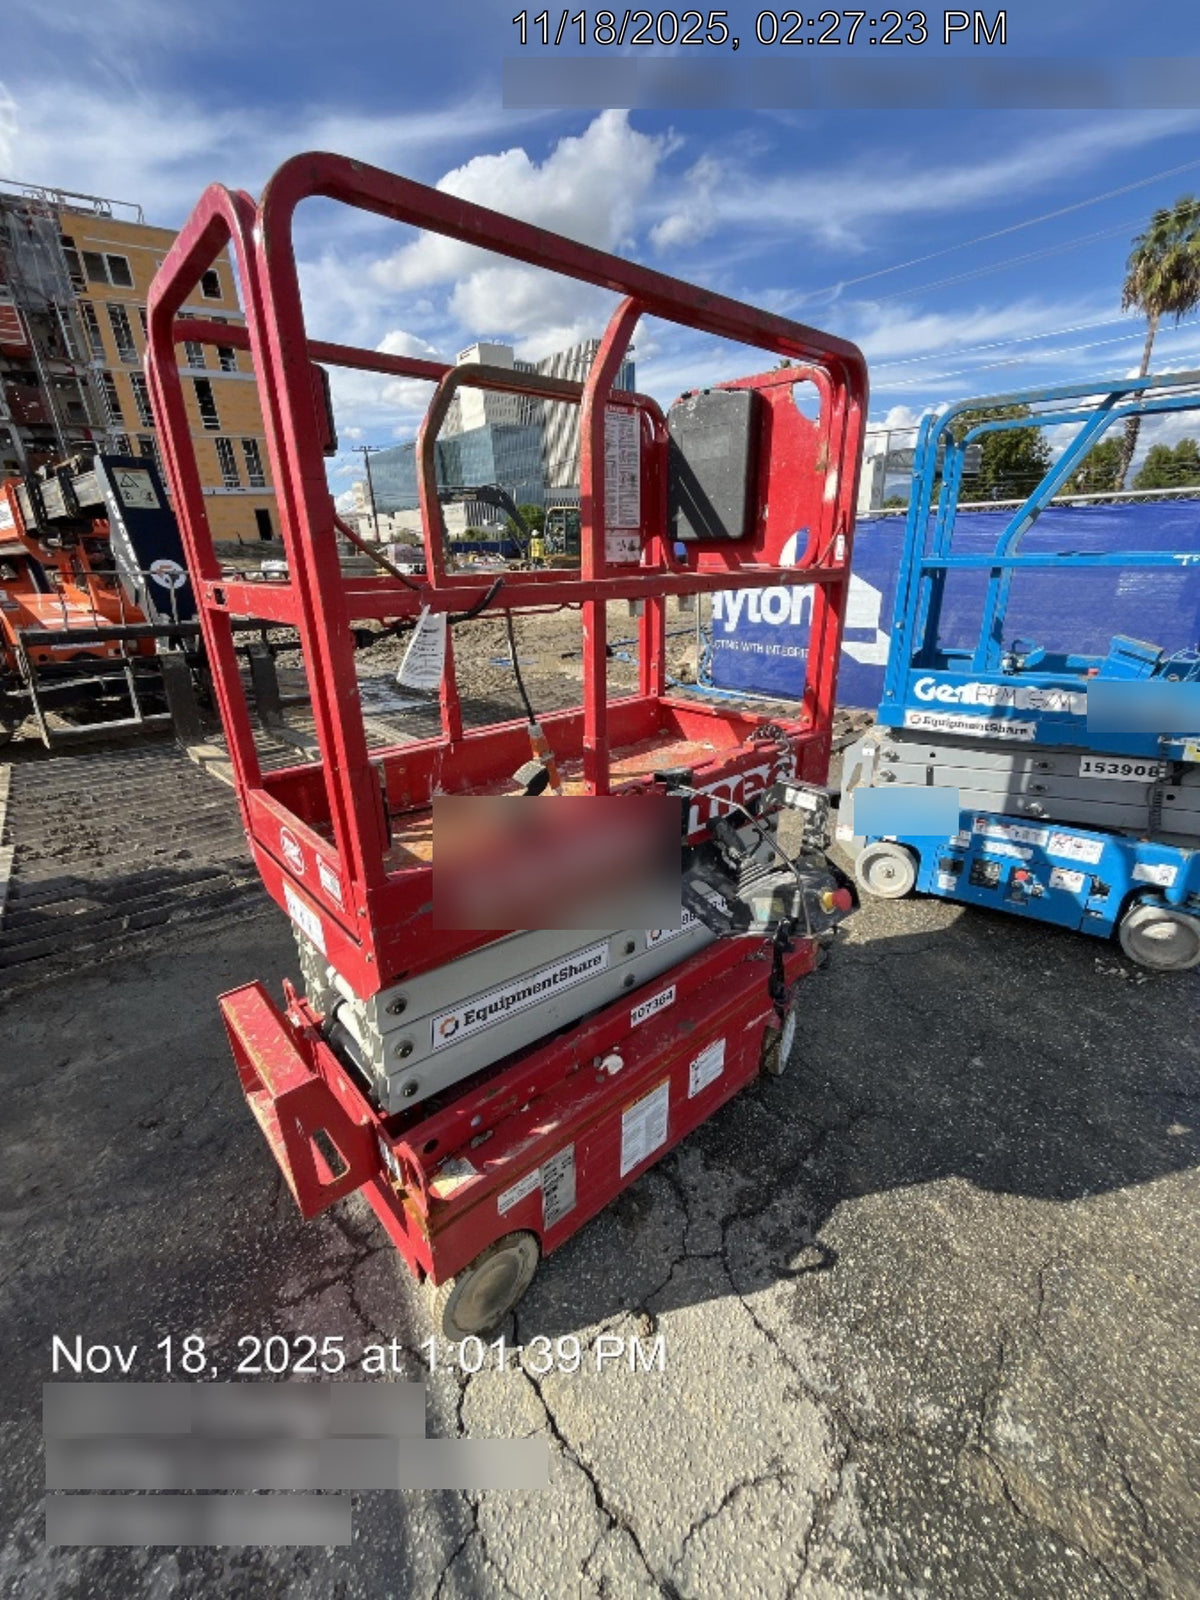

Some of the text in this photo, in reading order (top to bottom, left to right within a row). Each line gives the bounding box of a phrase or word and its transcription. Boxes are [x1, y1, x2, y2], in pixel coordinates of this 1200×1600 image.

[922, 715, 1030, 736] EquipmentShare
[1082, 761, 1160, 778] 153908
[463, 954, 603, 1028] EquipmentShare
[632, 989, 674, 1024] 107364
